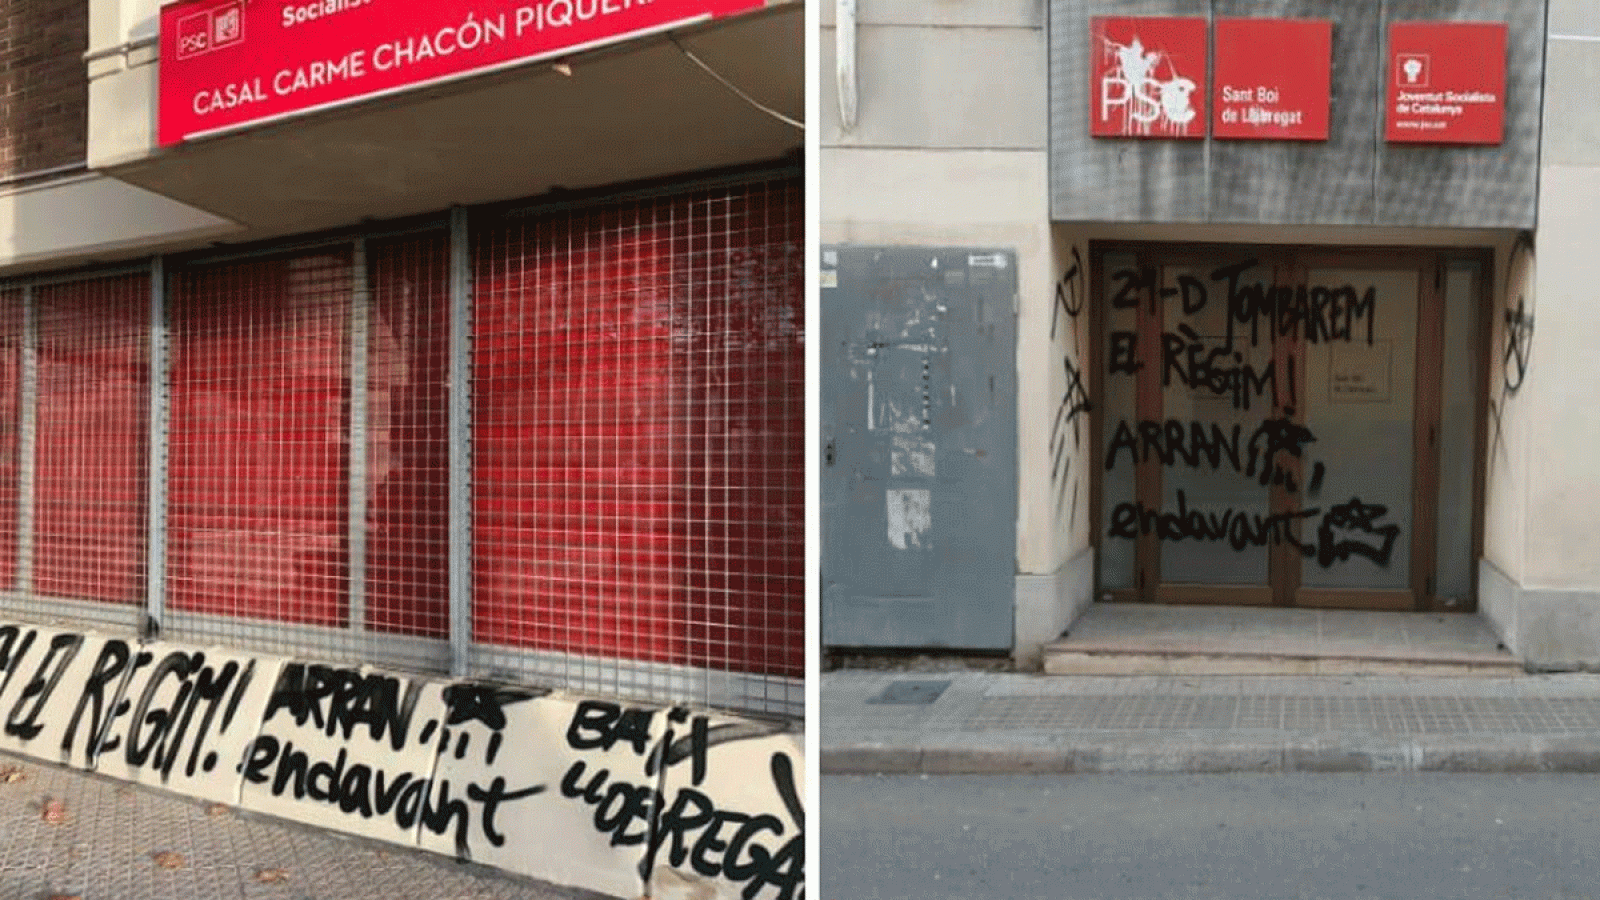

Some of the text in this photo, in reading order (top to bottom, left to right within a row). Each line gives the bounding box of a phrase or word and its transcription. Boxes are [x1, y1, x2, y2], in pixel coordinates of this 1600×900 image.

[179, 31, 207, 54] PSC
[192, 77, 268, 115] CASAL
[273, 50, 366, 96] CARME
[372, 12, 505, 70] CHACÓN
[1221, 107, 1237, 124] de
[1222, 85, 1279, 103] Sant Boi
[1210, 257, 1377, 349] TOMBAREM
[1109, 331, 1144, 376] EL
[1105, 419, 1242, 473] ARRAN
[1108, 488, 1321, 558] endavant
[264, 662, 422, 752] ARRAN
[237, 735, 547, 862] endavant
